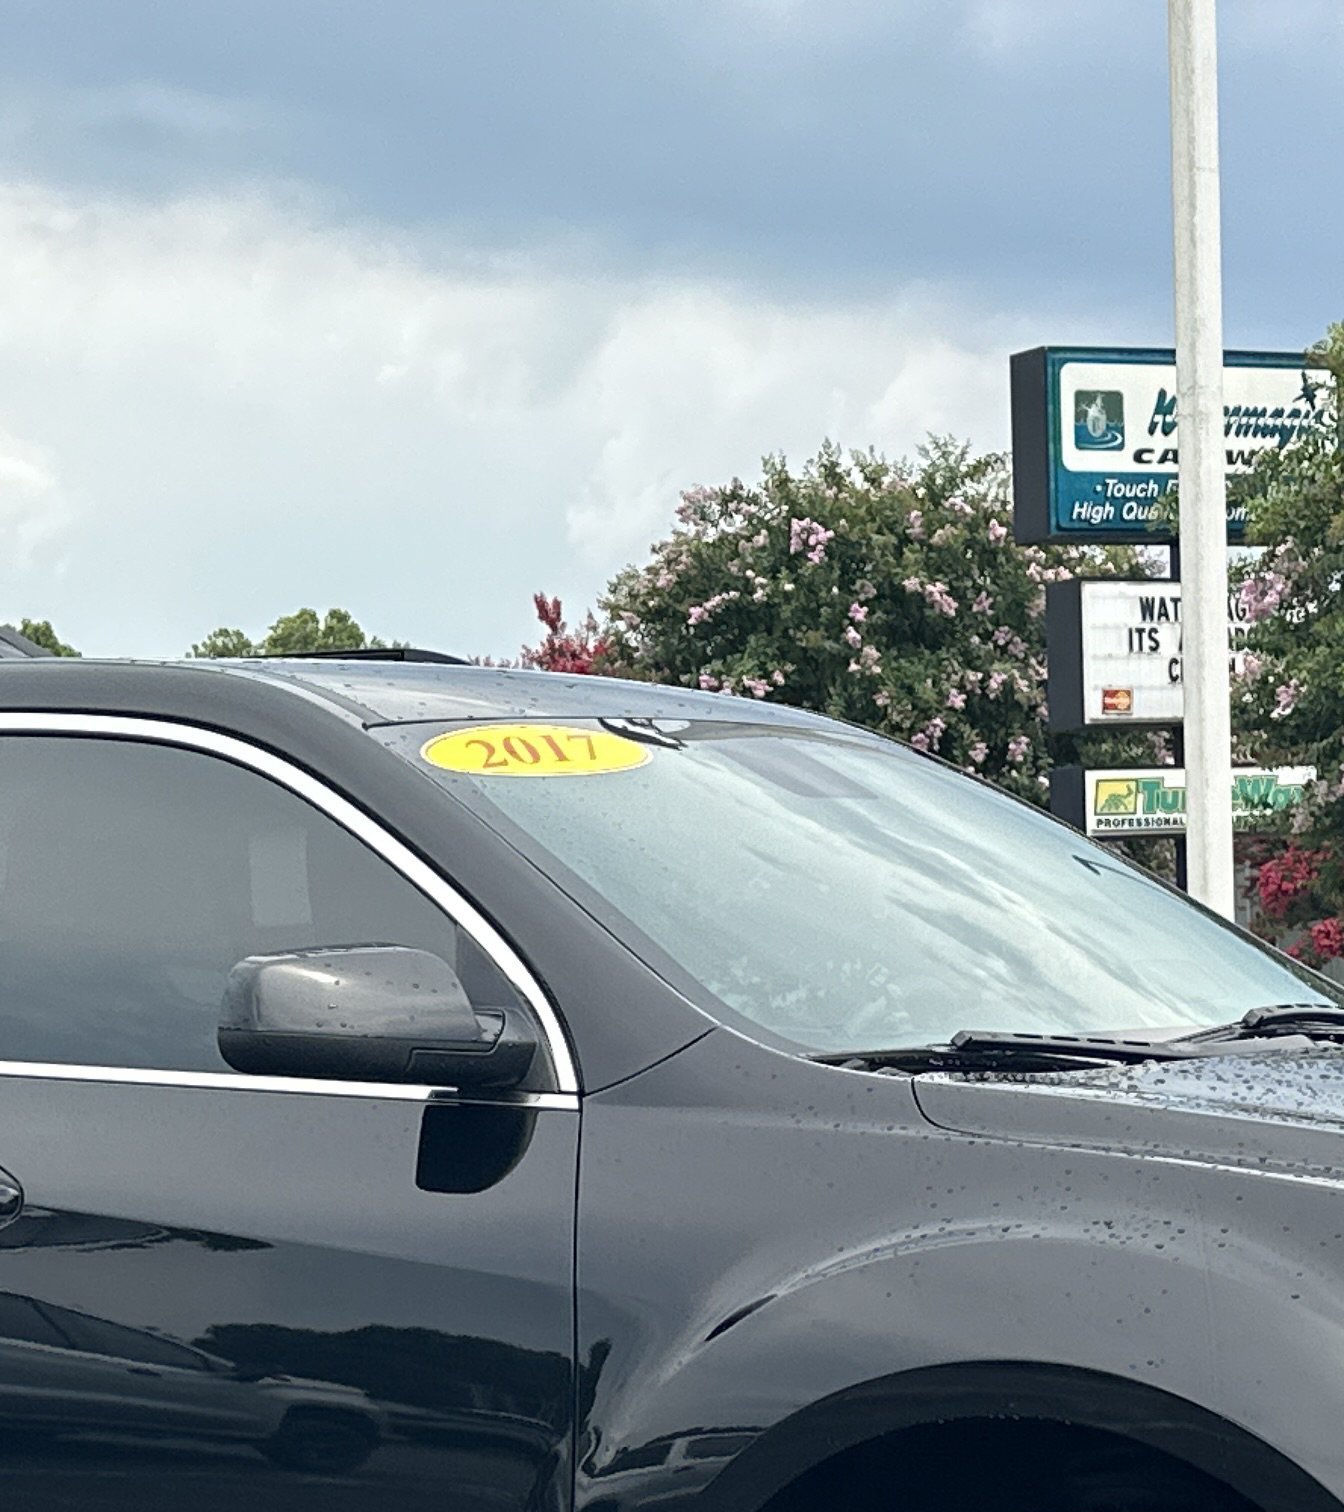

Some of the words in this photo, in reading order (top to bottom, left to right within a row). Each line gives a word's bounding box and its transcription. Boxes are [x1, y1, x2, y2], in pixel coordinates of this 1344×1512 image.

[1105, 479, 1159, 498] Touch
[1072, 501, 1114, 524] High
[1128, 627, 1160, 652] ITS
[465, 734, 597, 769] 2017
[1096, 817, 1186, 829] PROFESSIONAL
